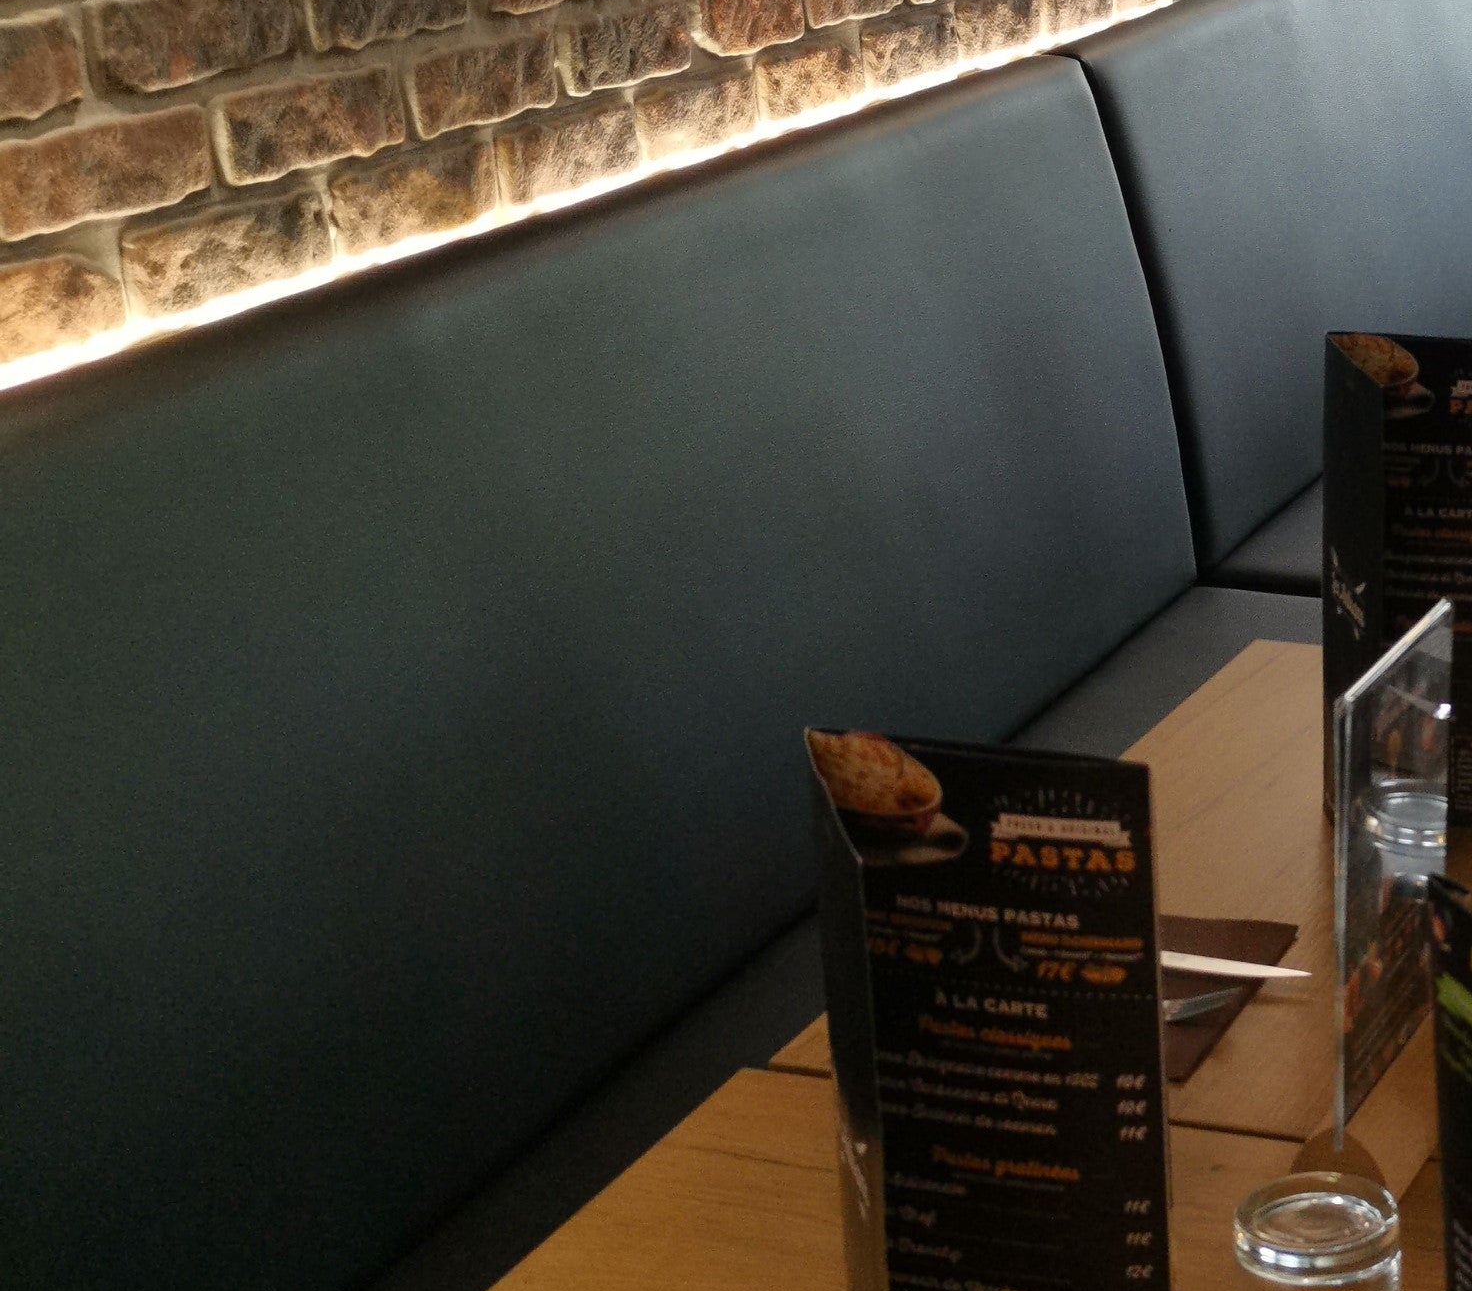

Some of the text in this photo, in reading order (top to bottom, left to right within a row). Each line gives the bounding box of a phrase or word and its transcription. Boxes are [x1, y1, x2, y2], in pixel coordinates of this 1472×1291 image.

[989, 839, 1137, 873] PASTAS
[1003, 907, 1080, 930] PASTAS
[983, 997, 1049, 1020] CARTE
